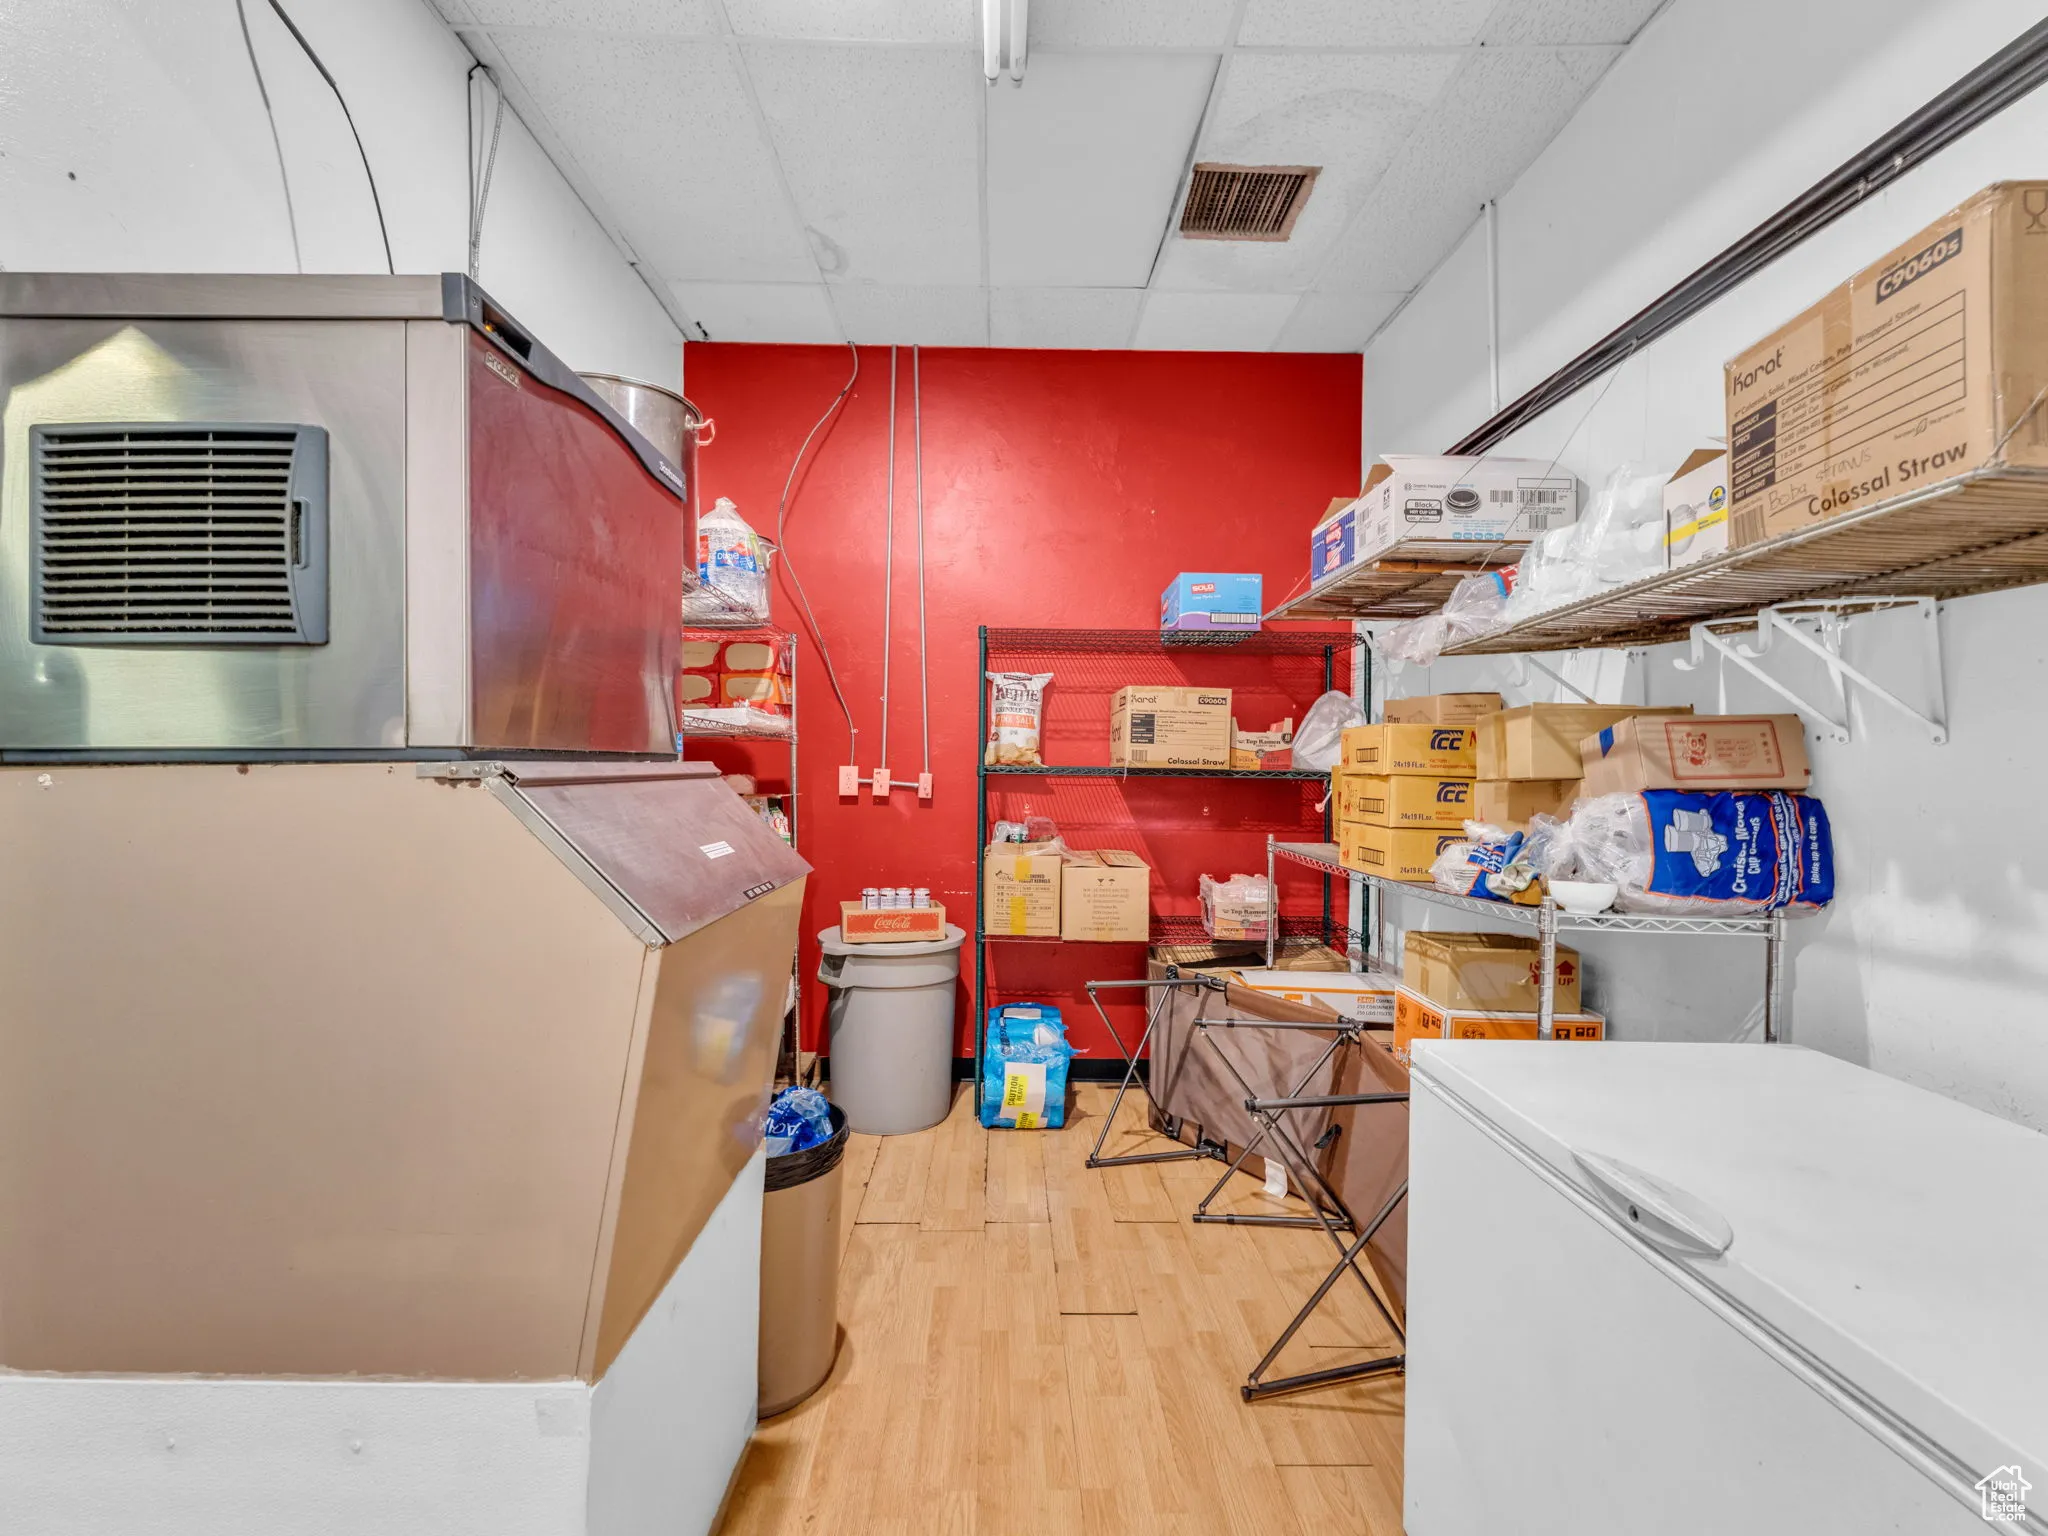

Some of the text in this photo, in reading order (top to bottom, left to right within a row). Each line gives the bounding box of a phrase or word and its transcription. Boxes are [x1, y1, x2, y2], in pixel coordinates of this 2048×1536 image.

[1879, 238, 1960, 297] C9060s
[1894, 303, 1921, 321] Straw
[1733, 348, 1782, 396] Karat
[1808, 442, 1967, 516] Colossal Straw
[1192, 583, 1214, 592] SOLO
[995, 682, 1039, 702] KETTLE
[1131, 694, 1226, 705] Karat C9060s
[1167, 757, 1226, 766] Colossal Straw
[1808, 816, 1819, 834] cups
[1810, 842, 1819, 850] to
[1811, 852, 1821, 861] up
[1748, 857, 1761, 875] Cup
[1810, 862, 1821, 884] Holds
[1557, 977, 1575, 986] UP
[1007, 1075, 1019, 1106] CAUTION
[1016, 1084, 1024, 1102] HEAVY
